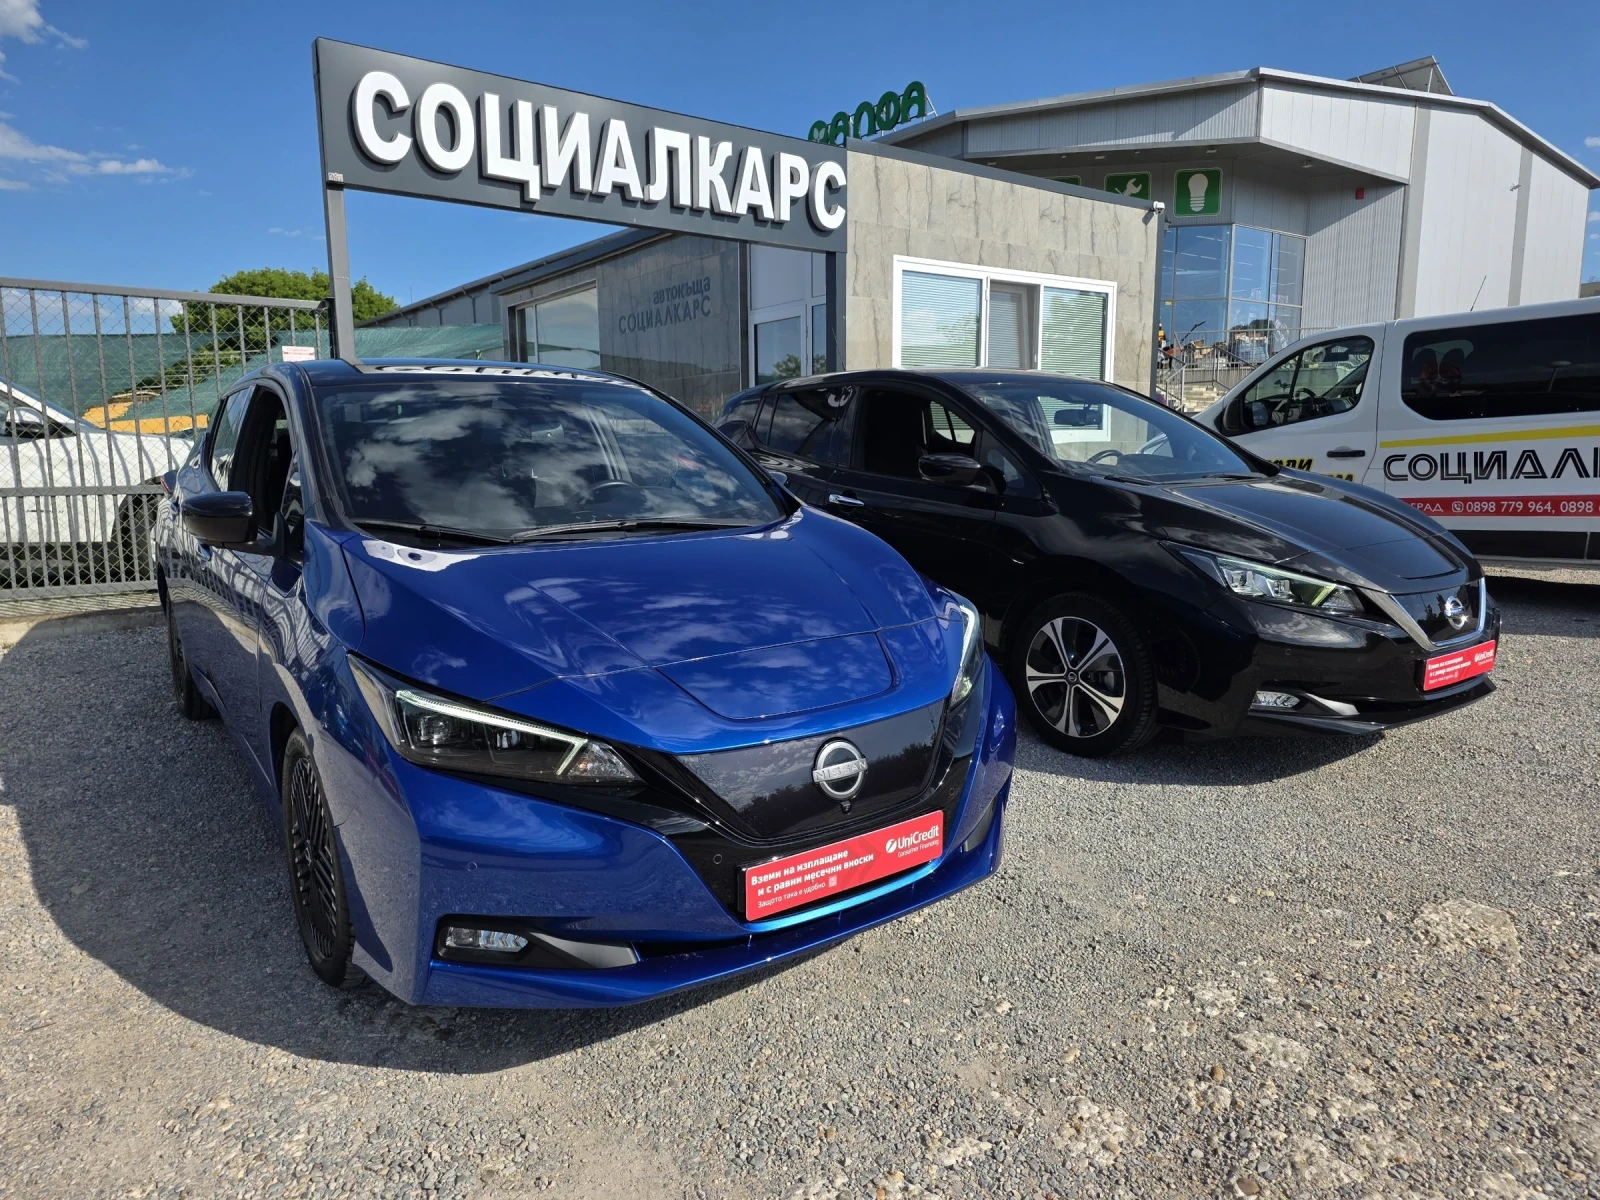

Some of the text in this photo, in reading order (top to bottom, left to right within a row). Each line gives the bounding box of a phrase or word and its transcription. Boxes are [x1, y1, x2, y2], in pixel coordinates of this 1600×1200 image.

[352, 70, 847, 231] СОЦИАЛКАРС
[653, 276, 711, 305] автокъща
[618, 295, 711, 334] СОЦИАЛКАРС
[1466, 501, 1496, 512] 0898
[1500, 501, 1523, 512] 779
[1528, 501, 1555, 514] 964,
[1560, 501, 1594, 513] 0898
[814, 759, 867, 782] NISSAN
[897, 825, 939, 849] UniCredit
[751, 850, 848, 886] Вземи на изплащане
[757, 853, 874, 896] и с равни месечни вноски
[757, 895, 782, 908] Защото
[783, 890, 798, 899] така
[804, 882, 826, 894] удобно
